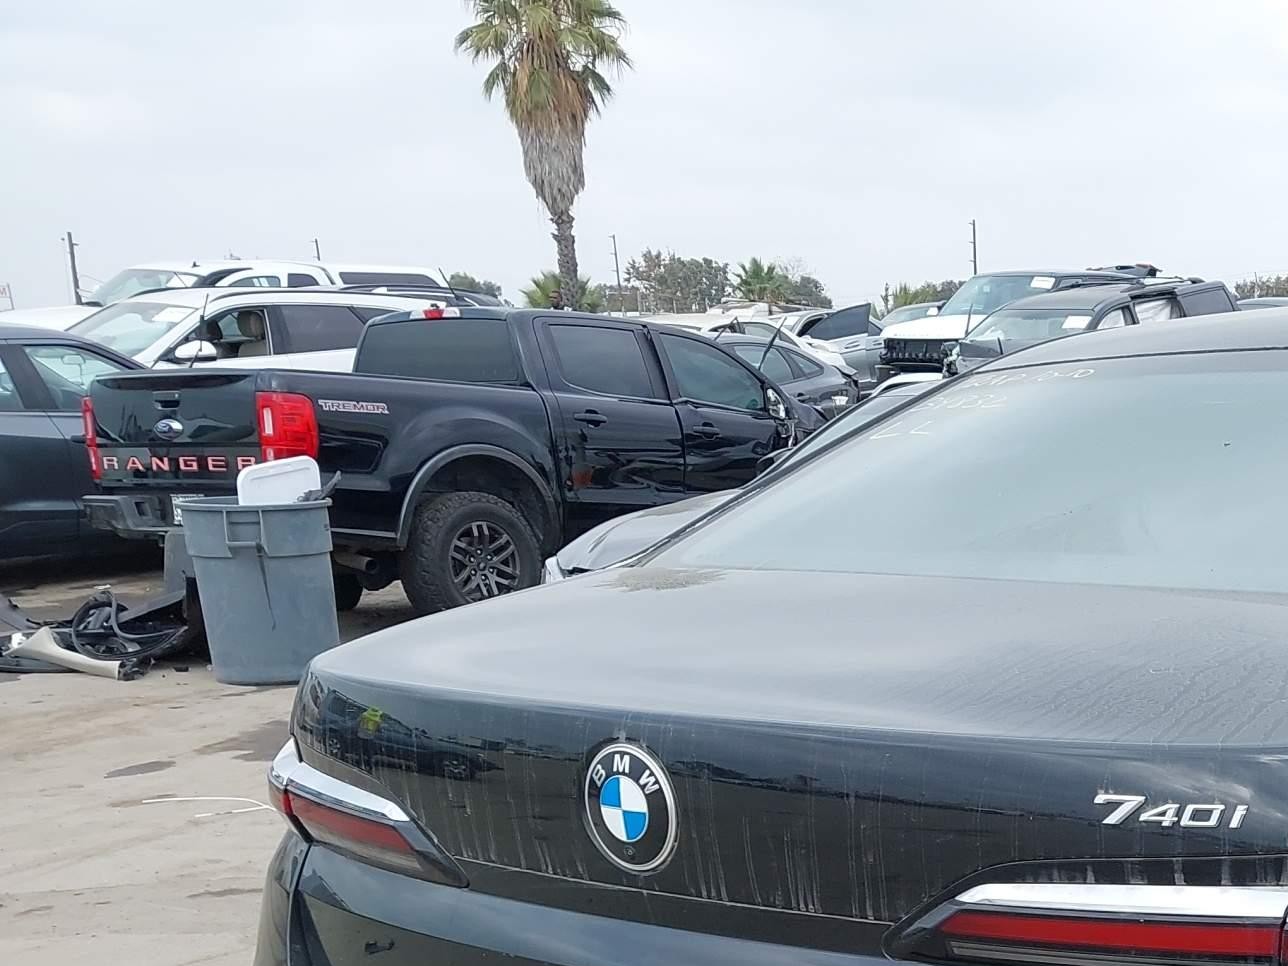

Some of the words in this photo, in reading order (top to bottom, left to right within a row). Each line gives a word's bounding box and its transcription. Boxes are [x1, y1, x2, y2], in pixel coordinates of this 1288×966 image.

[318, 399, 389, 414] TREMOR
[102, 456, 256, 472] RANGER
[592, 753, 660, 795] BMW
